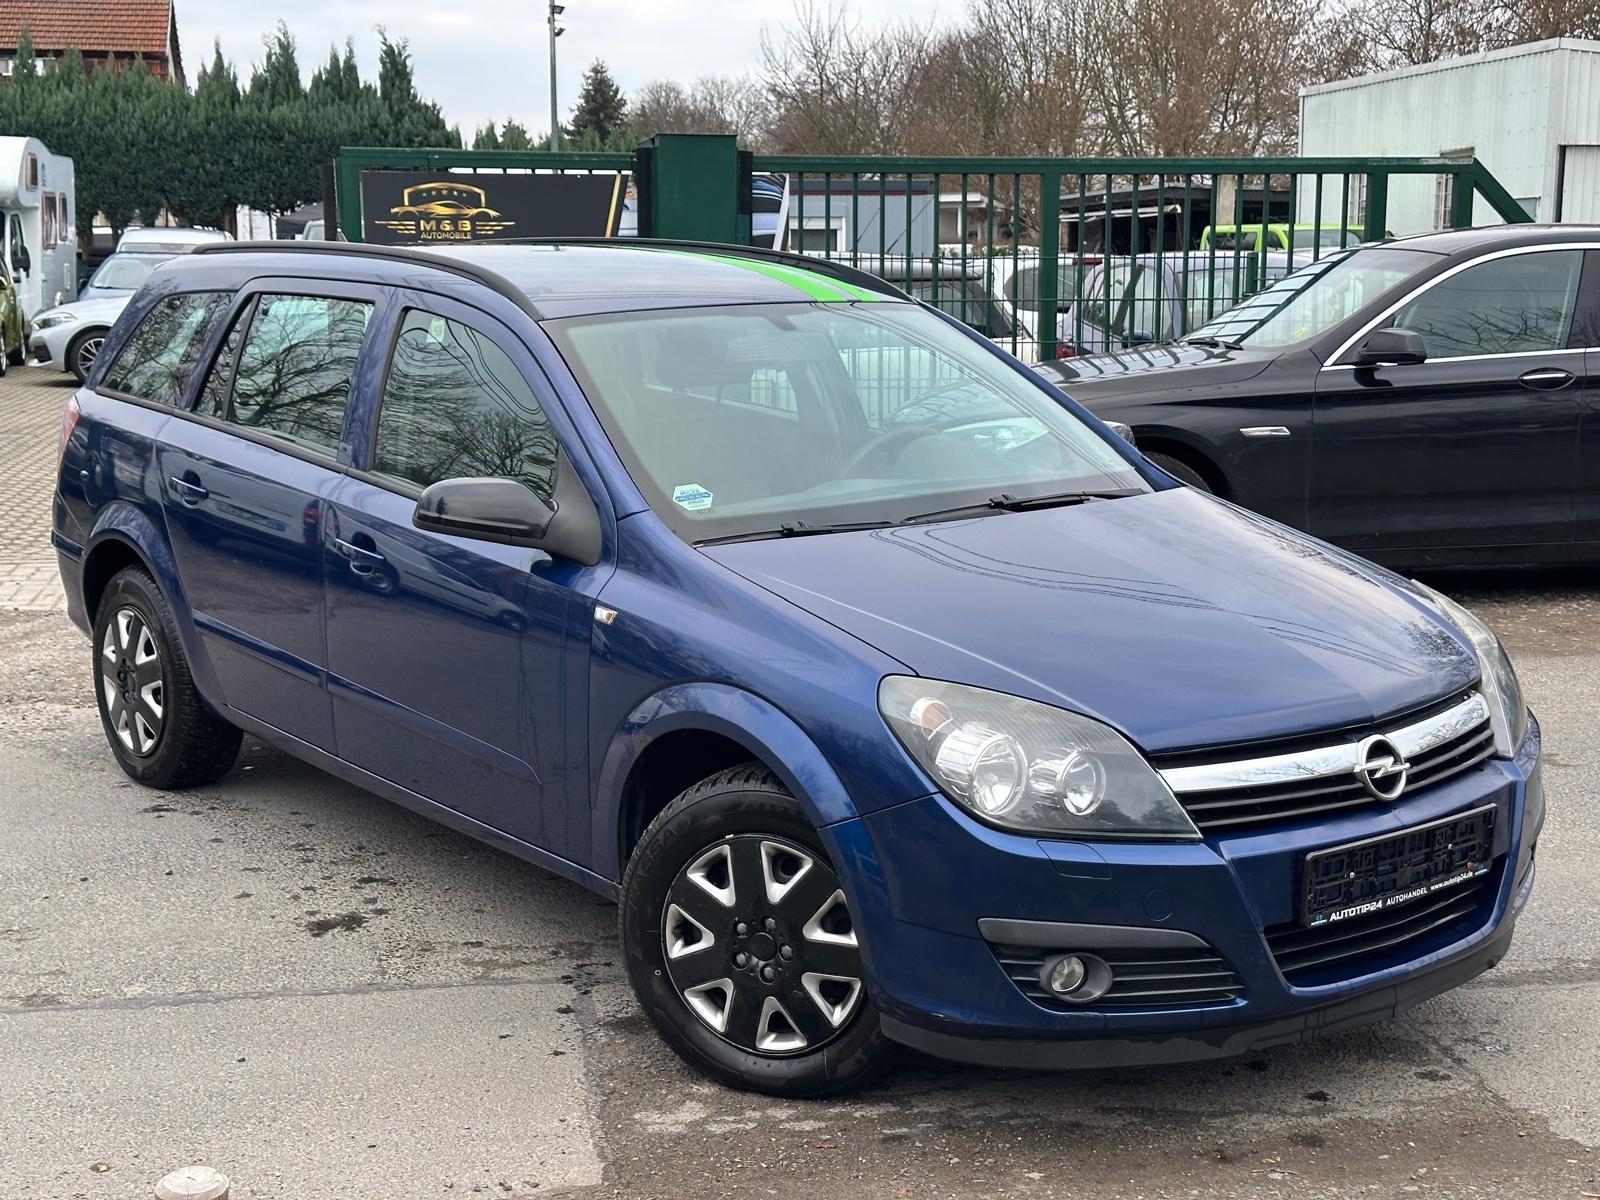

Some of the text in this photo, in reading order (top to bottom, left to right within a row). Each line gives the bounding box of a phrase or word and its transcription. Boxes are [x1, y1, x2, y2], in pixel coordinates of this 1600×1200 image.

[420, 219, 472, 231] M & B
[420, 231, 472, 240] AUTOMOBILE
[1329, 870, 1474, 922] AUTOTIP24 AUTOHANDEL www.autotip24.de
